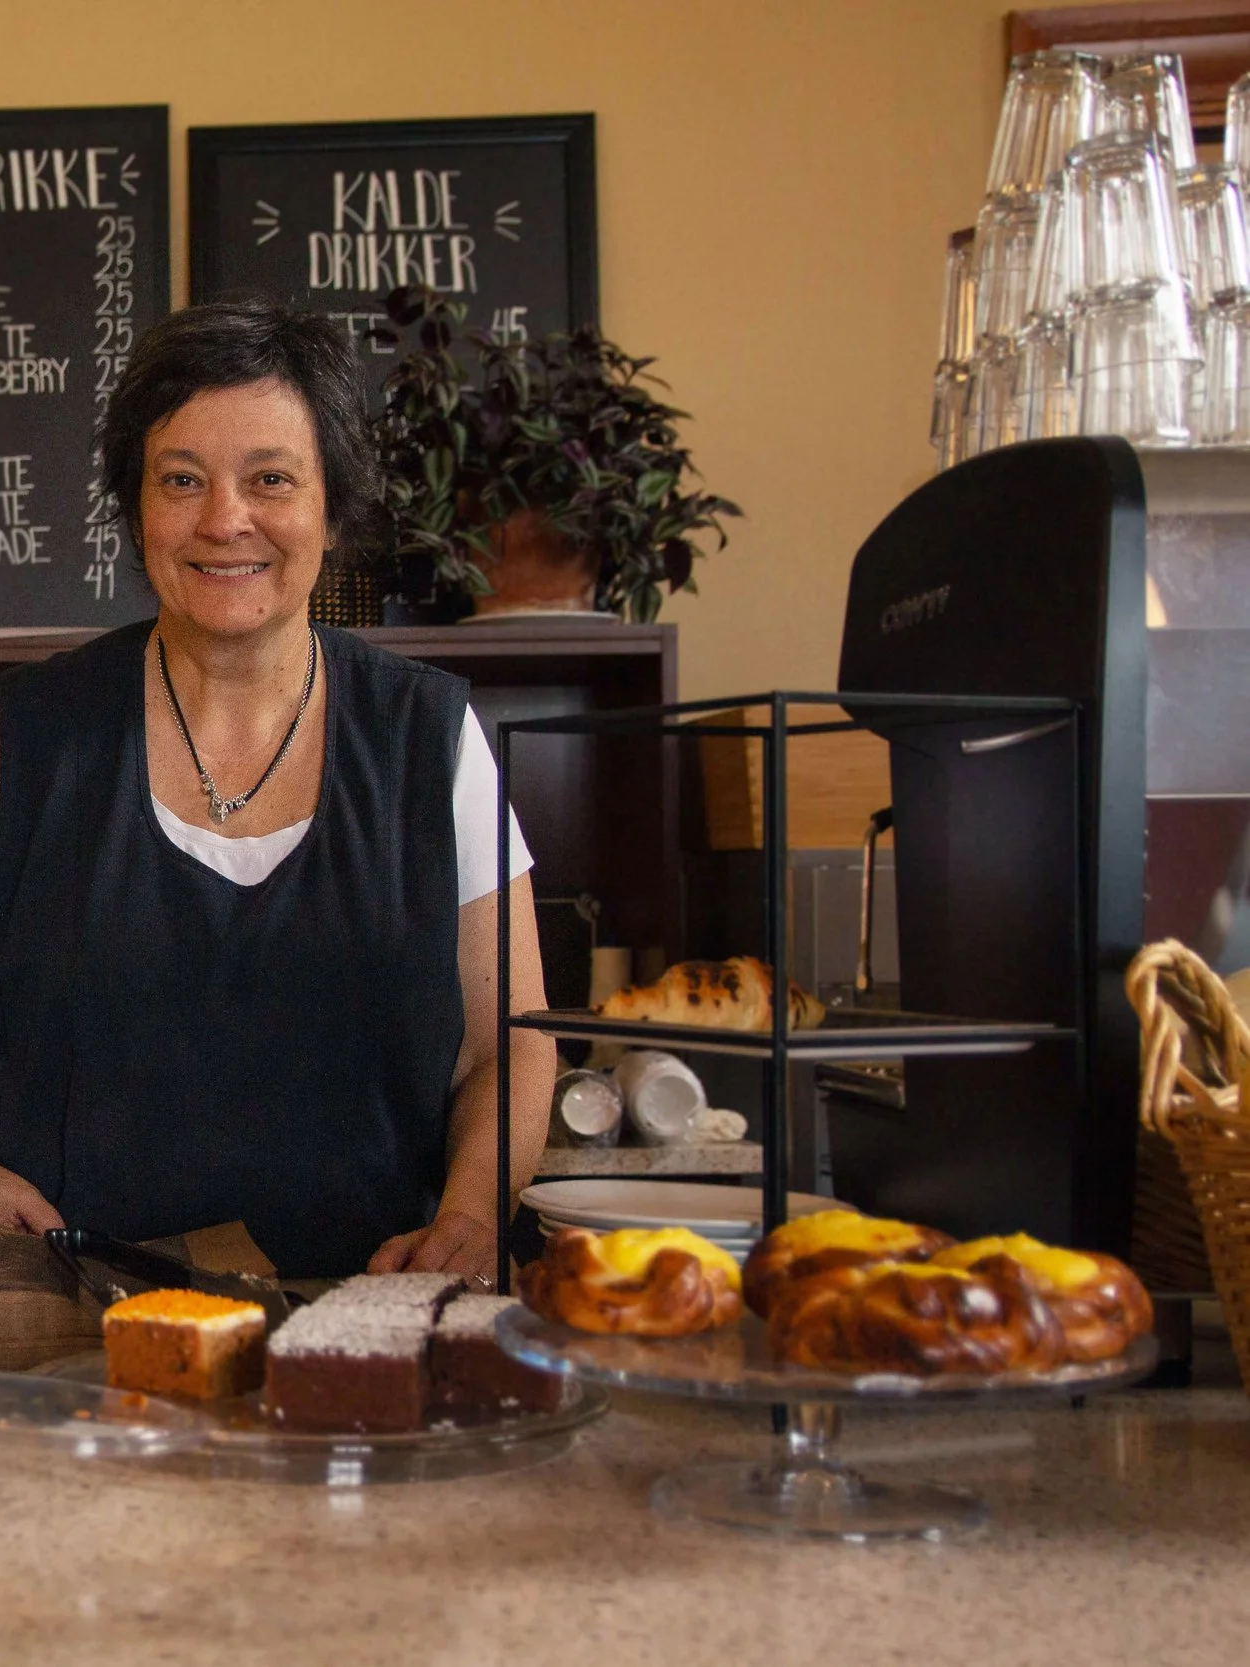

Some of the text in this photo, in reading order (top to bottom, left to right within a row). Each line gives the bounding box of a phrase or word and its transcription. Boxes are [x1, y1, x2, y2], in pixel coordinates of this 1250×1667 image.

[333, 169, 469, 232] KALDE
[95, 216, 136, 252] 25
[93, 249, 134, 281] 25
[309, 232, 478, 294] DRIKKER
[94, 281, 134, 318] 25
[3, 323, 36, 359] TE
[93, 317, 134, 356] 25
[83, 526, 121, 563] 45
[83, 563, 115, 600] 41
